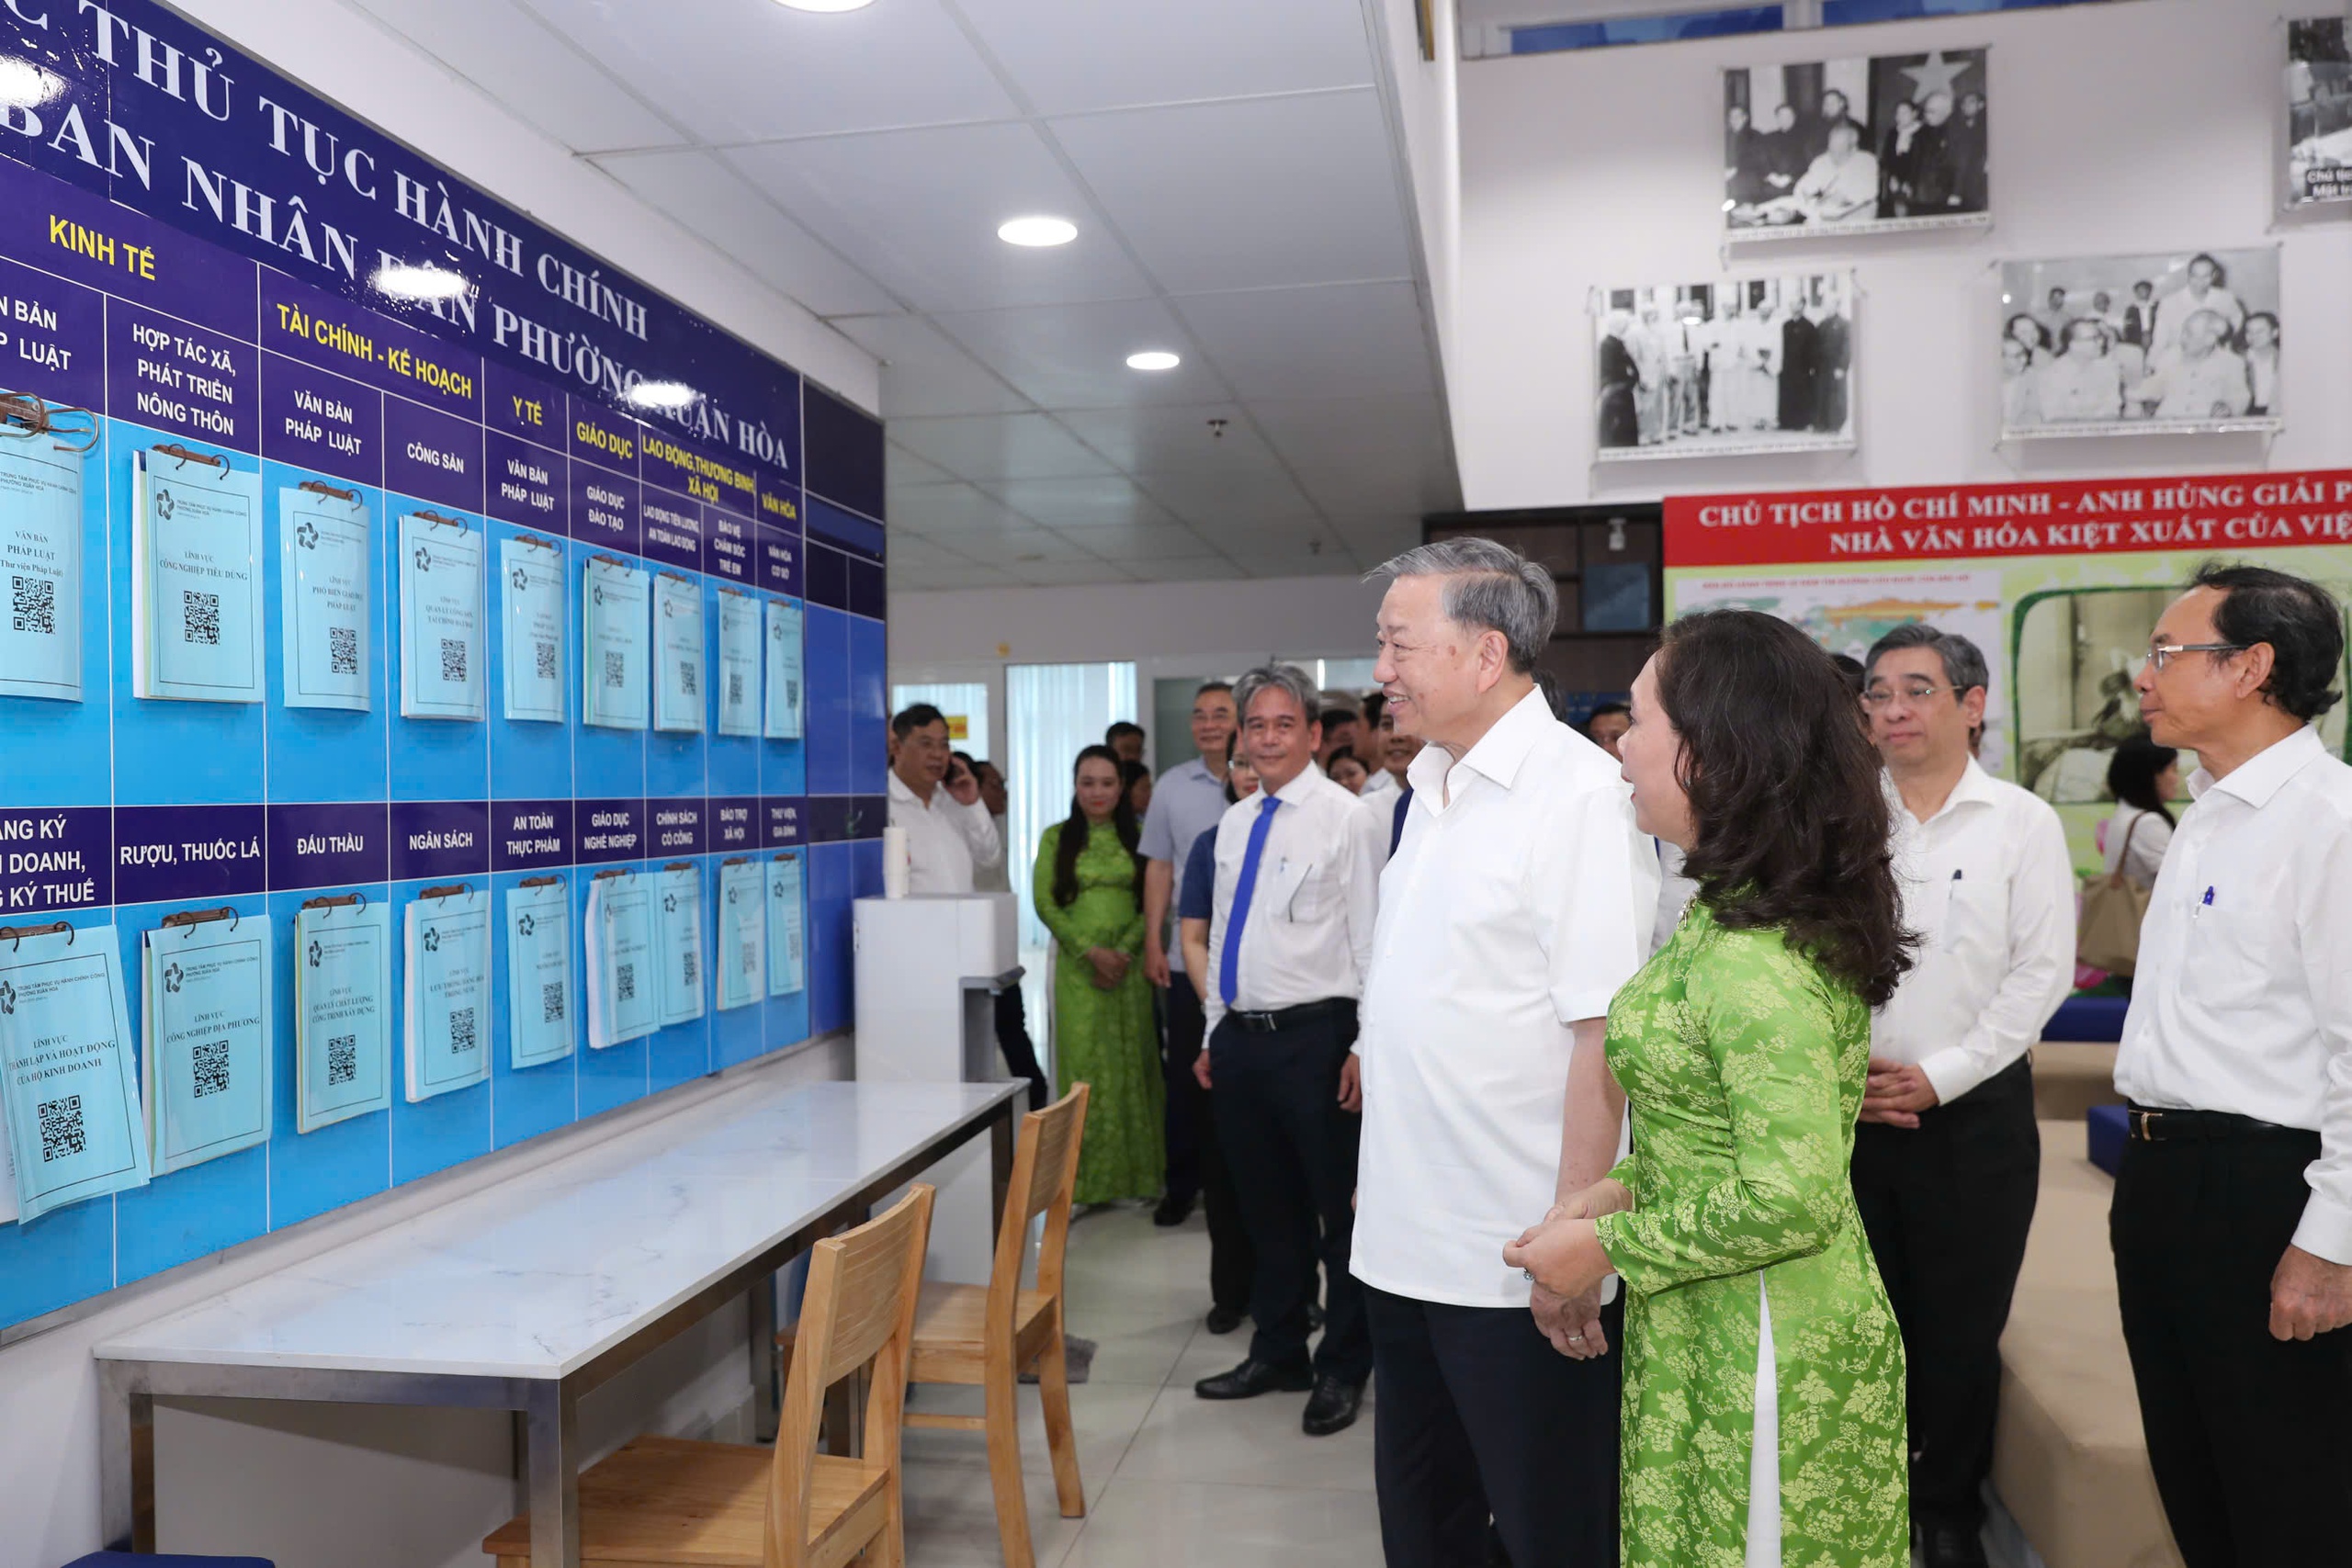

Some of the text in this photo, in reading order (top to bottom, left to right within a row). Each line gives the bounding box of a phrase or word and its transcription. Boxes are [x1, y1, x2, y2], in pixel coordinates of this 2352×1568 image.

[79, 0, 648, 341] THỦ TỤC HÀNH CHÍNH
[50, 214, 155, 280] KINH TẾ
[15, 299, 57, 331] BẢN
[181, 156, 358, 278] NHÂN
[738, 419, 789, 470] HÒA
[19, 337, 72, 371] LUẬT
[132, 323, 236, 377] HỢP TÁC XÃ,
[277, 303, 310, 339] TÀI
[314, 320, 373, 362] CHÍNH
[388, 347, 412, 377] KẾ
[415, 358, 472, 399] HOẠCH
[138, 358, 232, 404] PHÁT TRIỂN
[137, 392, 234, 435] NÔNG THÔN
[294, 390, 353, 424] VĂN BẢN
[513, 395, 543, 425] Y TẾ
[286, 417, 362, 457] PHÁP LUẬT
[576, 422, 633, 459] GIÁO DỤC
[643, 434, 663, 458] LAO
[407, 442, 464, 474] CÔNG SẢN
[507, 459, 548, 486] VĂN BẢN
[502, 483, 555, 513] PHÁP LUẬT
[586, 485, 625, 510] GIÁO DỤC
[1699, 499, 1760, 527] CHỦ
[1769, 501, 1842, 528] TỊCH
[1852, 495, 1896, 522] HỒ
[1903, 491, 1959, 519] CHÍ
[1967, 492, 2052, 517] MINH
[2076, 489, 2145, 513] ANH
[2252, 477, 2325, 505] GIẢI
[588, 508, 624, 533] ĐÀO TẠO
[1830, 525, 1894, 553] NHÀ
[1901, 525, 1964, 550] VĂN
[1973, 521, 2039, 549] HÓA
[2047, 517, 2122, 548] KIỆT
[2130, 511, 2219, 543] XUẤT
[2224, 510, 2292, 539] CỦA
[7, 544, 32, 556] PHÁP
[32, 565, 48, 575] Pháp
[0, 814, 67, 840] NG KÝ
[513, 812, 553, 830] AN TOÀN
[592, 811, 629, 828] GIÁO DỤC
[120, 836, 261, 867] RƯỢU, THUỐC LÁ
[297, 832, 364, 855] ĐẤU THẦU
[409, 829, 473, 851] NGÂN SÁCH
[506, 840, 533, 857] THỰC
[584, 833, 637, 850] NGHỀ NGHIỆP
[9, 851, 85, 874] DOANH,
[10, 880, 38, 908] KÝ
[42, 877, 95, 905] THUẾ
[44, 1066, 66, 1078] KINH
[68, 1058, 102, 1073] DOANH
